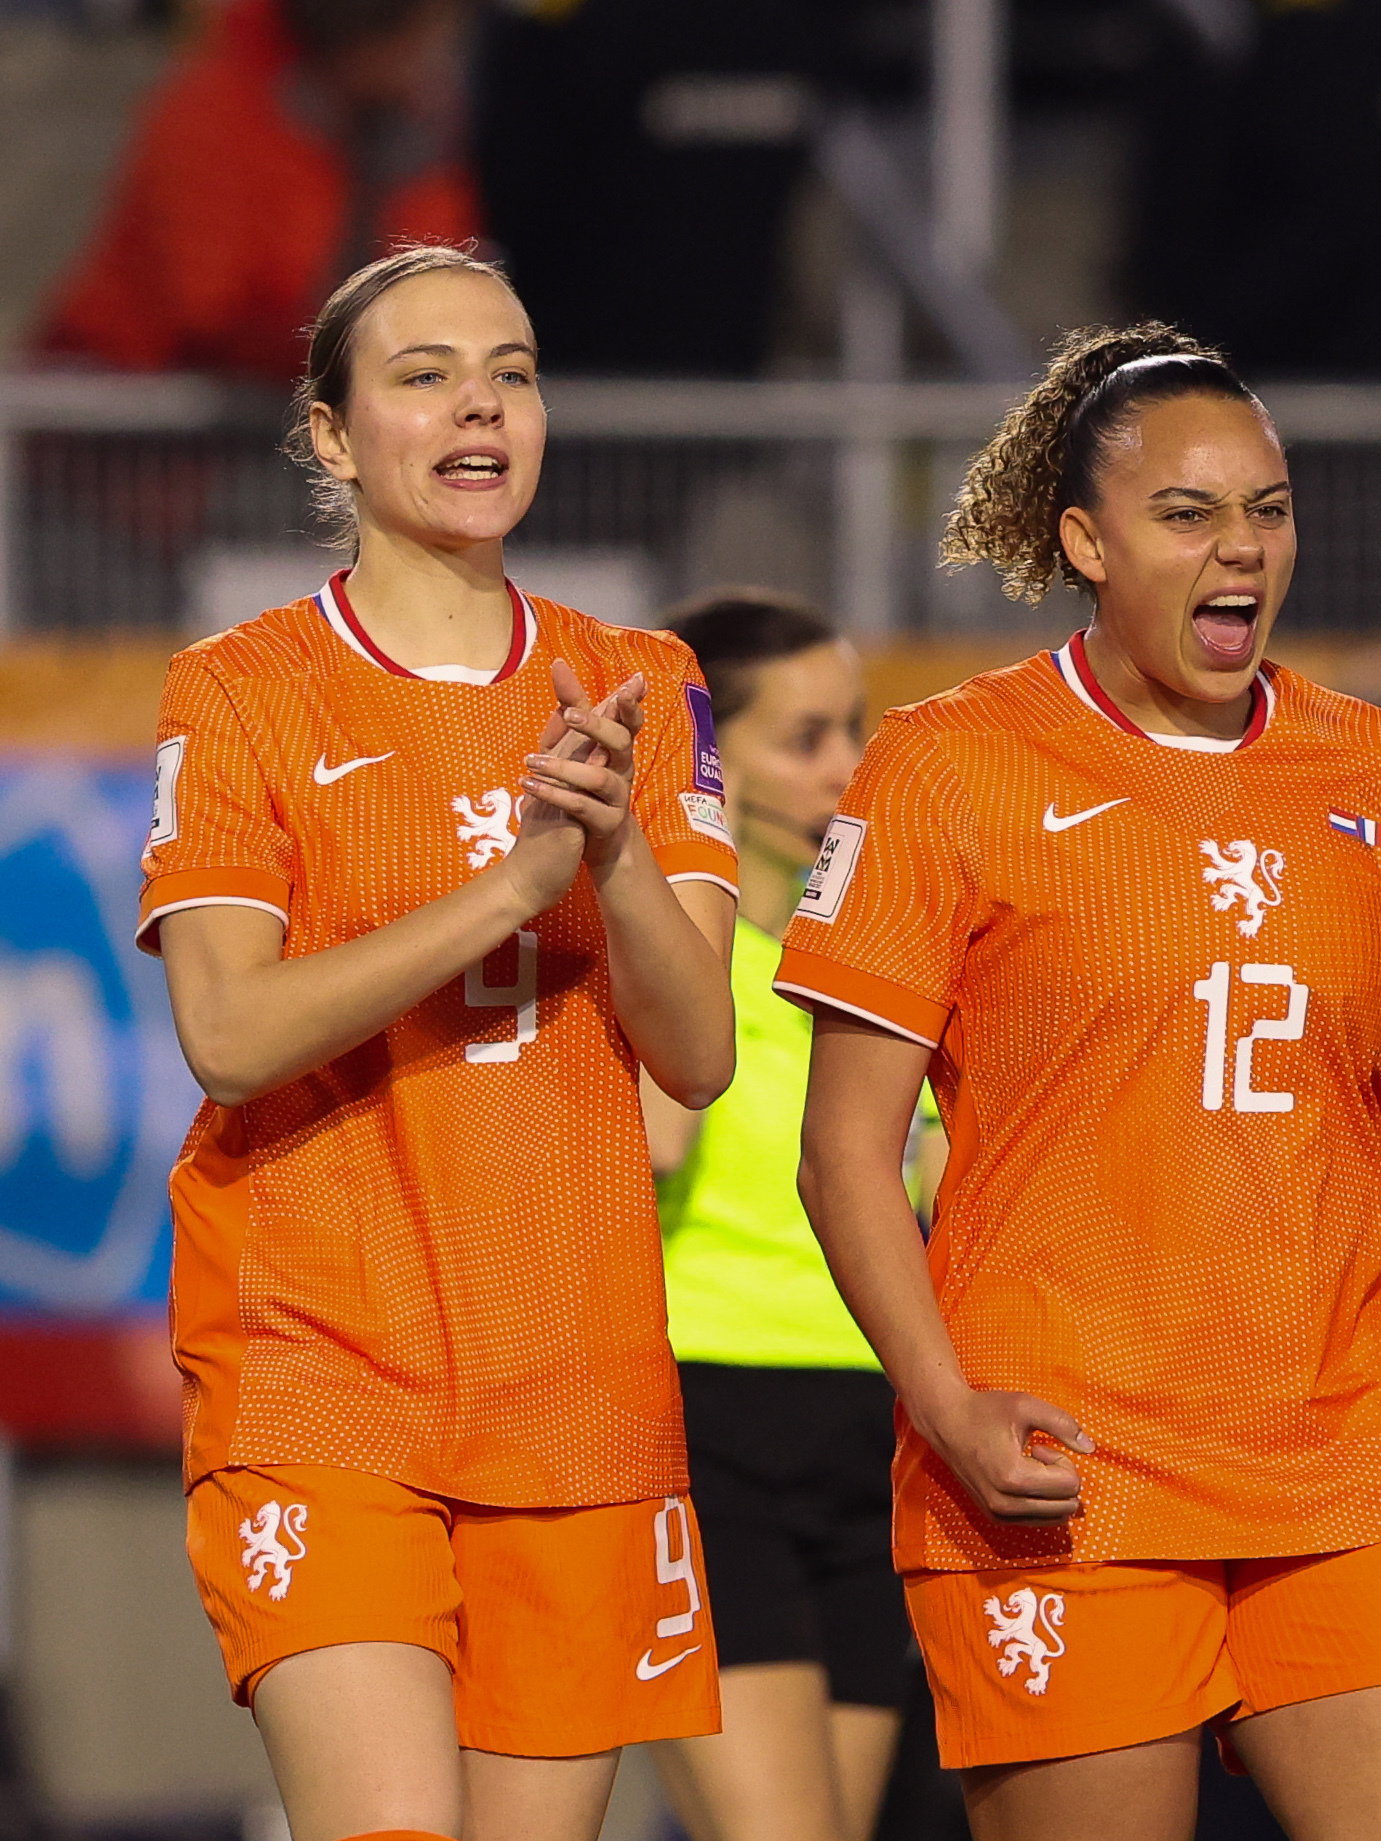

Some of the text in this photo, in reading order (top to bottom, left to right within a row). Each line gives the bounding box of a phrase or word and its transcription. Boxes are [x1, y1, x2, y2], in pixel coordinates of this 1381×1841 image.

[464, 929, 539, 1064] 9
[1193, 961, 1310, 1113] 12
[653, 1497, 701, 1638] 9
